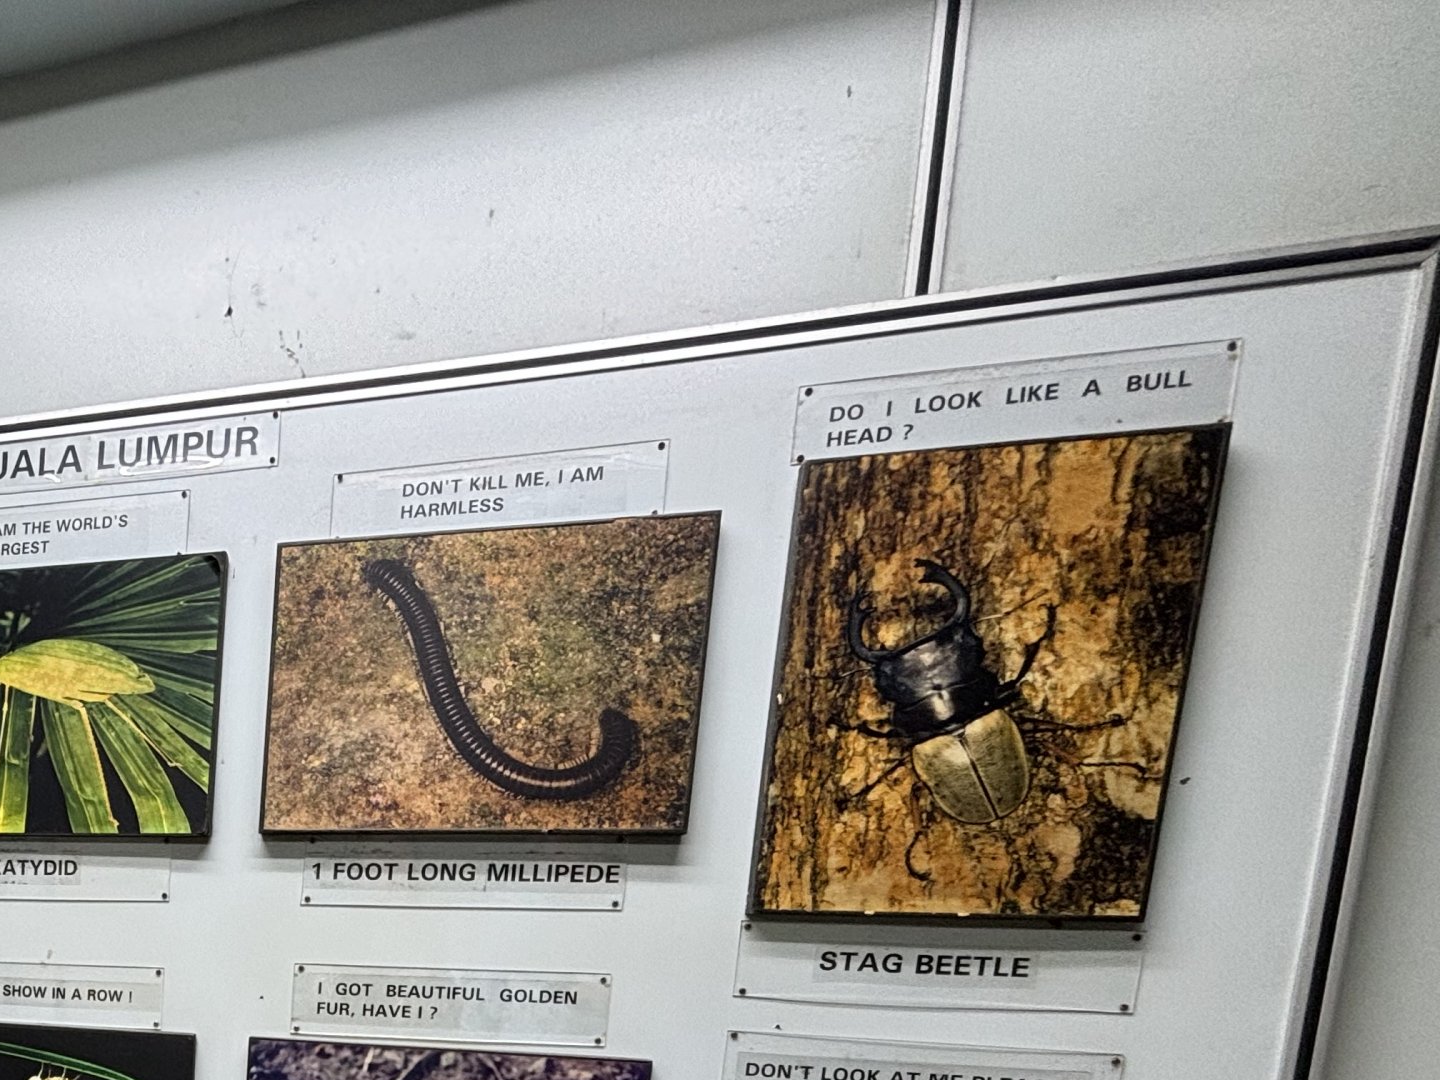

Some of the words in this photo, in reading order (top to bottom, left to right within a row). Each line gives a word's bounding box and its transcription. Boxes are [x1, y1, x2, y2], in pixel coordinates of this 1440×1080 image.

[829, 403, 863, 424] DO
[886, 401, 892, 417] I
[914, 391, 983, 415] LOOK
[1005, 382, 1059, 405] LIKE
[1082, 379, 1101, 398] A
[1126, 370, 1193, 393] BULL
[826, 425, 893, 448] HEAD
[97, 425, 259, 471] LUMPUR
[402, 478, 462, 497] DON'T
[469, 474, 508, 492] KILL
[515, 471, 550, 487] ME,
[558, 469, 563, 484] I
[569, 465, 604, 483] AM
[400, 497, 504, 519] HARMLESS
[22, 520, 51, 535] THE
[56, 514, 128, 533] WORLD'S
[311, 863, 322, 880] 1
[333, 862, 399, 881] FOOT
[407, 863, 476, 882] LONG
[486, 863, 620, 884] MILLIPEDE
[819, 951, 903, 974] STAG
[915, 954, 1030, 978] BEETLE
[2, 984, 47, 999] SHOW
[52, 987, 66, 999] IN
[72, 988, 83, 1000] A
[87, 988, 124, 1002] ROW
[317, 982, 322, 995] I
[335, 982, 373, 997] GOT
[386, 984, 486, 1001] BEAUTIFUL
[499, 989, 578, 1005] GOLDEN
[316, 1002, 355, 1018] FUR,
[361, 1004, 412, 1019] HAVE
[418, 1006, 423, 1019] I
[429, 1006, 438, 1020] ?
[745, 1062, 814, 1080] DON'T
